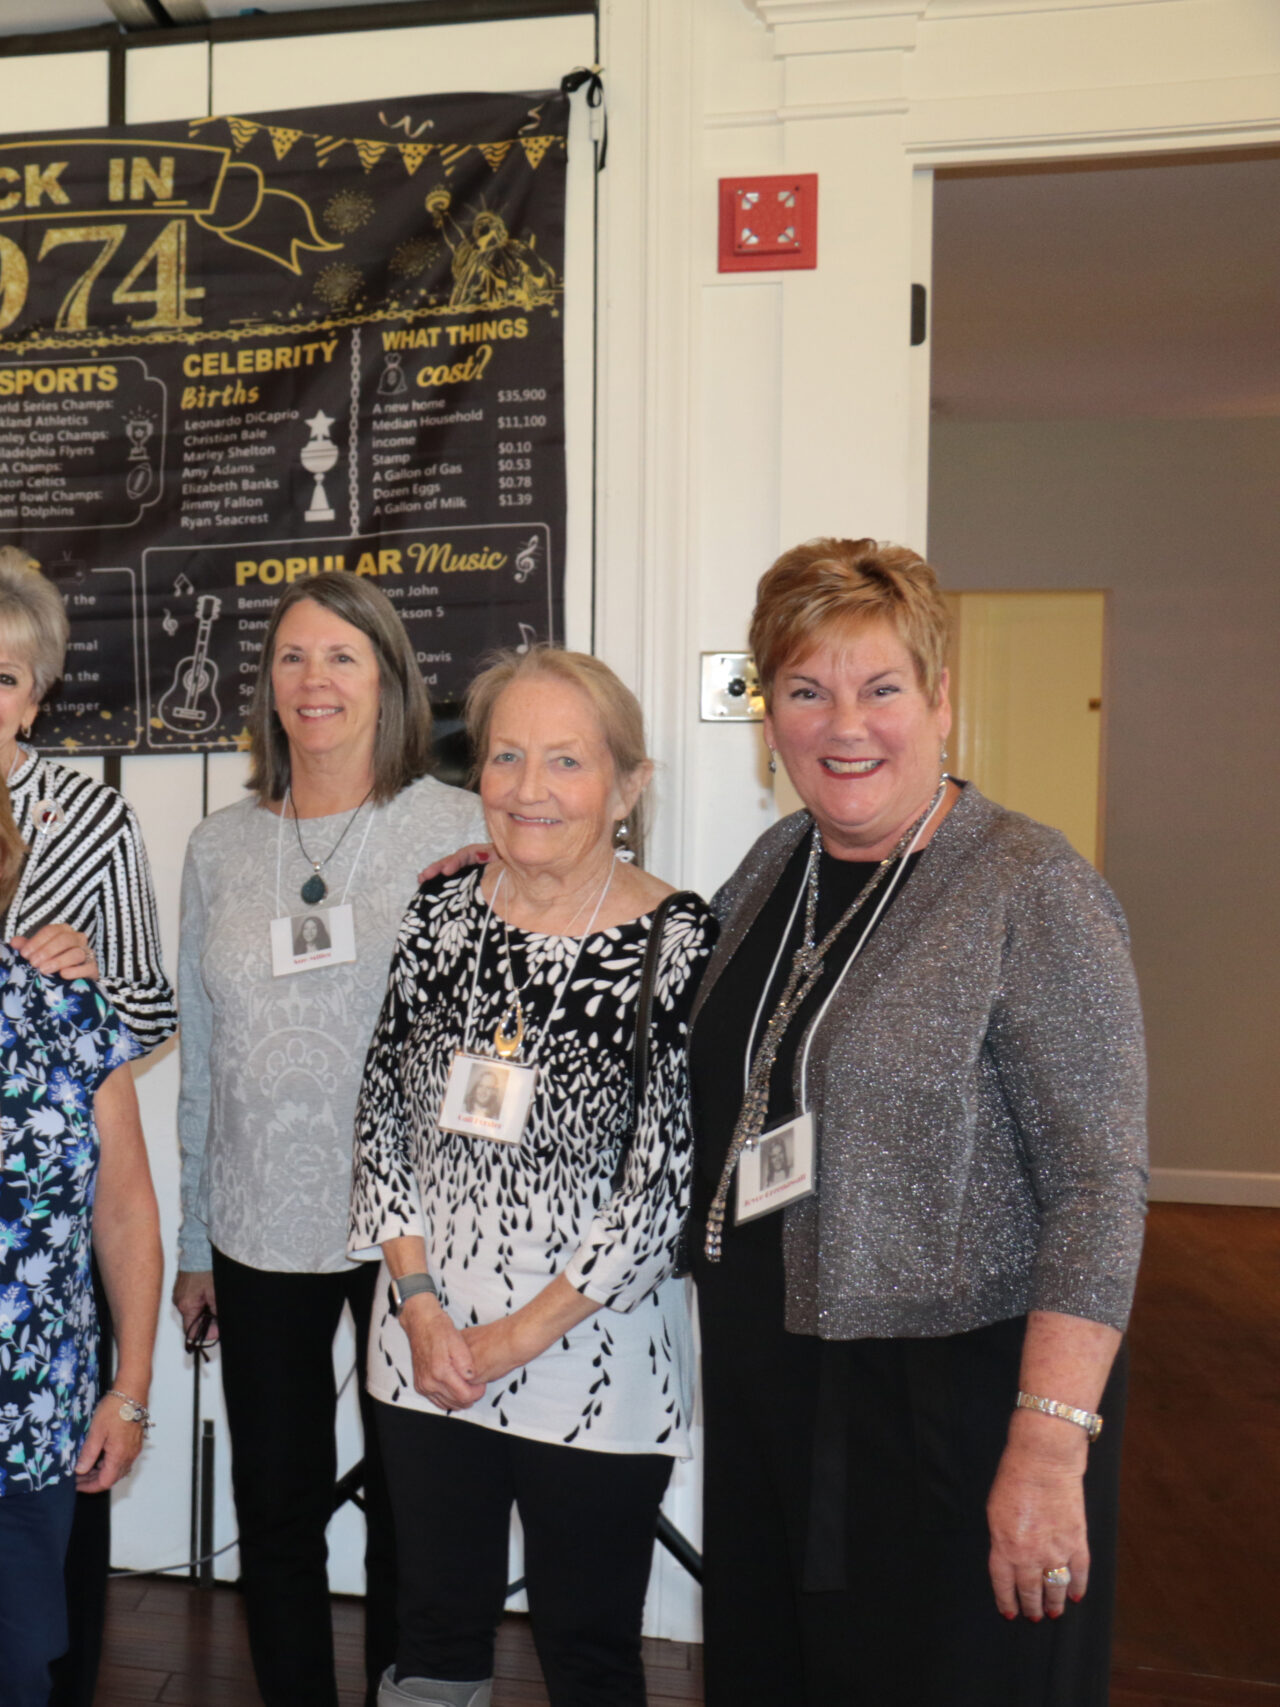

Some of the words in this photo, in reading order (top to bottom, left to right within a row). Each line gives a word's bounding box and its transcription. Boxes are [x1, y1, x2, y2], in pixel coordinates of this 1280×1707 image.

[108, 156, 176, 202] IN
[382, 327, 442, 351] WHAT
[445, 318, 529, 346] THINGS
[183, 339, 338, 378] CELEBRITY
[416, 344, 493, 387] cost?
[180, 378, 260, 411] Births
[497, 389, 547, 403] $35,900
[23, 401, 58, 411] Series
[62, 399, 114, 411] Champs:
[373, 403, 382, 415] A
[384, 403, 409, 413] new
[412, 398, 446, 412] home
[35, 415, 88, 426] Athletics
[185, 417, 242, 431] Leonardo
[245, 409, 300, 424] DiCaprio
[372, 419, 418, 431] Median
[420, 409, 484, 427] Household
[497, 415, 547, 429] $11,100
[29, 431, 54, 443] Cup
[57, 430, 109, 441] Champs:
[183, 433, 238, 447] Christian
[241, 429, 267, 441] Bale
[372, 435, 416, 448] income
[59, 446, 95, 458] Flyers
[183, 450, 224, 462] Marley
[228, 445, 276, 459] Shelton
[498, 441, 532, 454] $0.10
[372, 452, 410, 466] Stamp
[498, 459, 532, 472] $0.53
[12, 462, 63, 474] Champs:
[182, 466, 208, 479] Amy
[212, 463, 255, 475] Adams
[373, 472, 382, 483] A
[384, 469, 422, 482] Gallon
[424, 464, 438, 476] of
[440, 463, 463, 475] Gas
[26, 477, 66, 487] Celtics
[182, 480, 238, 495] Elizabeth
[241, 478, 279, 490] Banks
[499, 476, 532, 489] $0.78
[20, 492, 49, 502] Bowl
[52, 490, 103, 503] Champs:
[373, 486, 409, 500] Dozen
[412, 483, 441, 495] Eggs
[181, 499, 220, 511] Jimmy
[224, 497, 263, 508] Fallon
[373, 506, 382, 516] A
[384, 502, 422, 514] Gallon
[424, 499, 437, 510] of
[440, 496, 467, 509] Milk
[499, 494, 532, 507] $1.39
[21, 506, 75, 519] Dolphins
[181, 516, 211, 530] Ryan
[215, 513, 269, 526] Seacrest
[407, 542, 508, 574] Music
[408, 585, 439, 597] John
[74, 595, 96, 605] the
[436, 606, 445, 618] 5
[239, 640, 263, 652] The
[417, 651, 452, 663] Davis
[78, 670, 100, 681] the
[56, 701, 100, 713] singer
